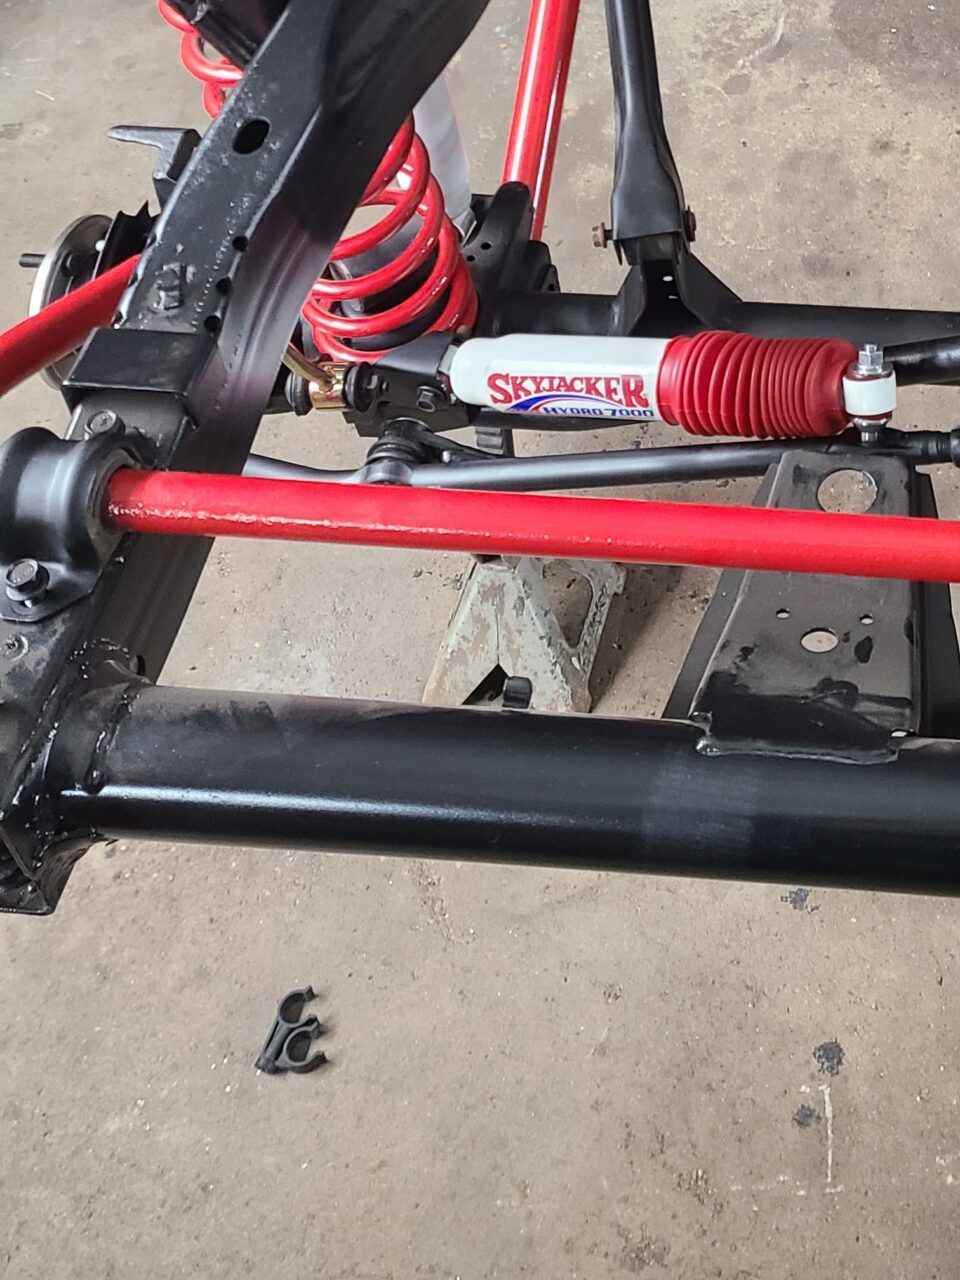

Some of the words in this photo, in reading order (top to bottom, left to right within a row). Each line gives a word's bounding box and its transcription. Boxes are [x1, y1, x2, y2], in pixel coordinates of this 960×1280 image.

[487, 373, 649, 408] SKYJACKER
[542, 407, 603, 417] HYDRO
[605, 408, 654, 417] 7000
